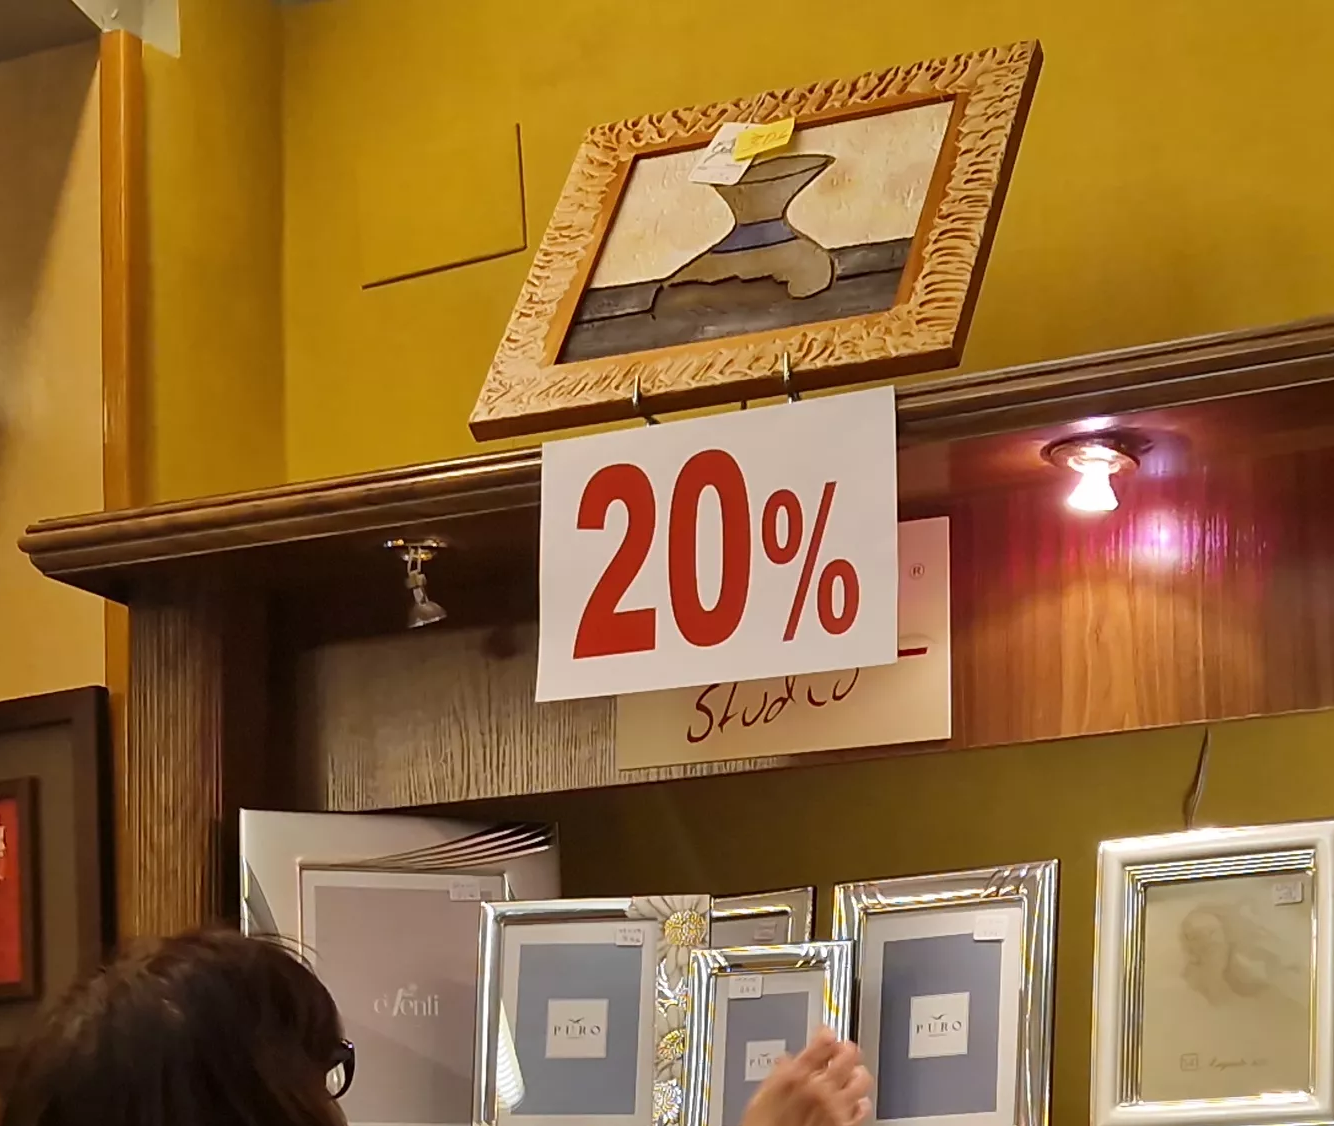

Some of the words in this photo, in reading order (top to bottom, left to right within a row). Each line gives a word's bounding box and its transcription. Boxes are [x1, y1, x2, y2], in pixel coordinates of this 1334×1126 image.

[572, 448, 861, 660] 20%
[553, 1024, 601, 1037] PURO
[916, 1020, 962, 1035] PURO
